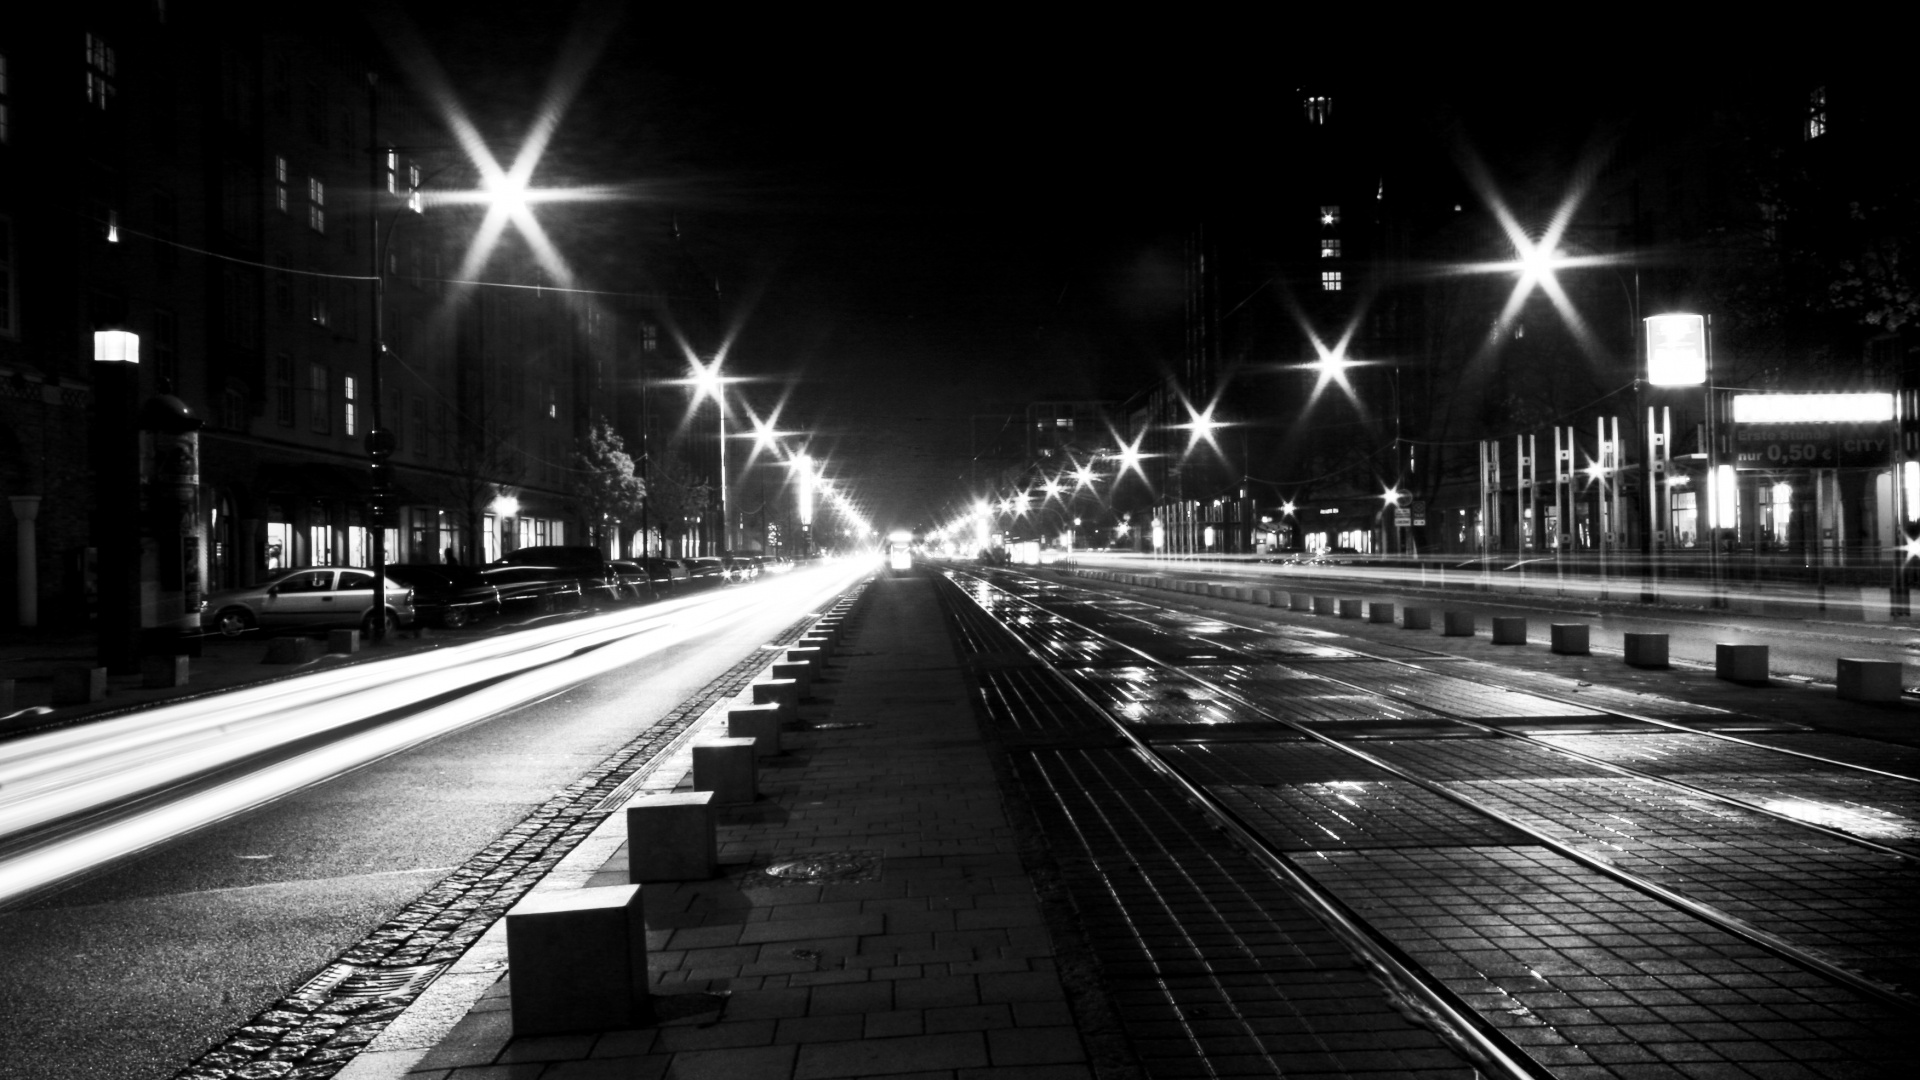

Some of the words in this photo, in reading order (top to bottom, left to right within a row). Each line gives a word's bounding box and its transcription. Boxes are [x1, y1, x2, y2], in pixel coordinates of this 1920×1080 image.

[1738, 430, 1775, 441] Erste
[1781, 429, 1830, 440] Stunde
[1844, 439, 1885, 452] CITY
[1738, 452, 1763, 461] nur
[1767, 444, 1816, 464] 0,50
[1822, 449, 1832, 461] €
